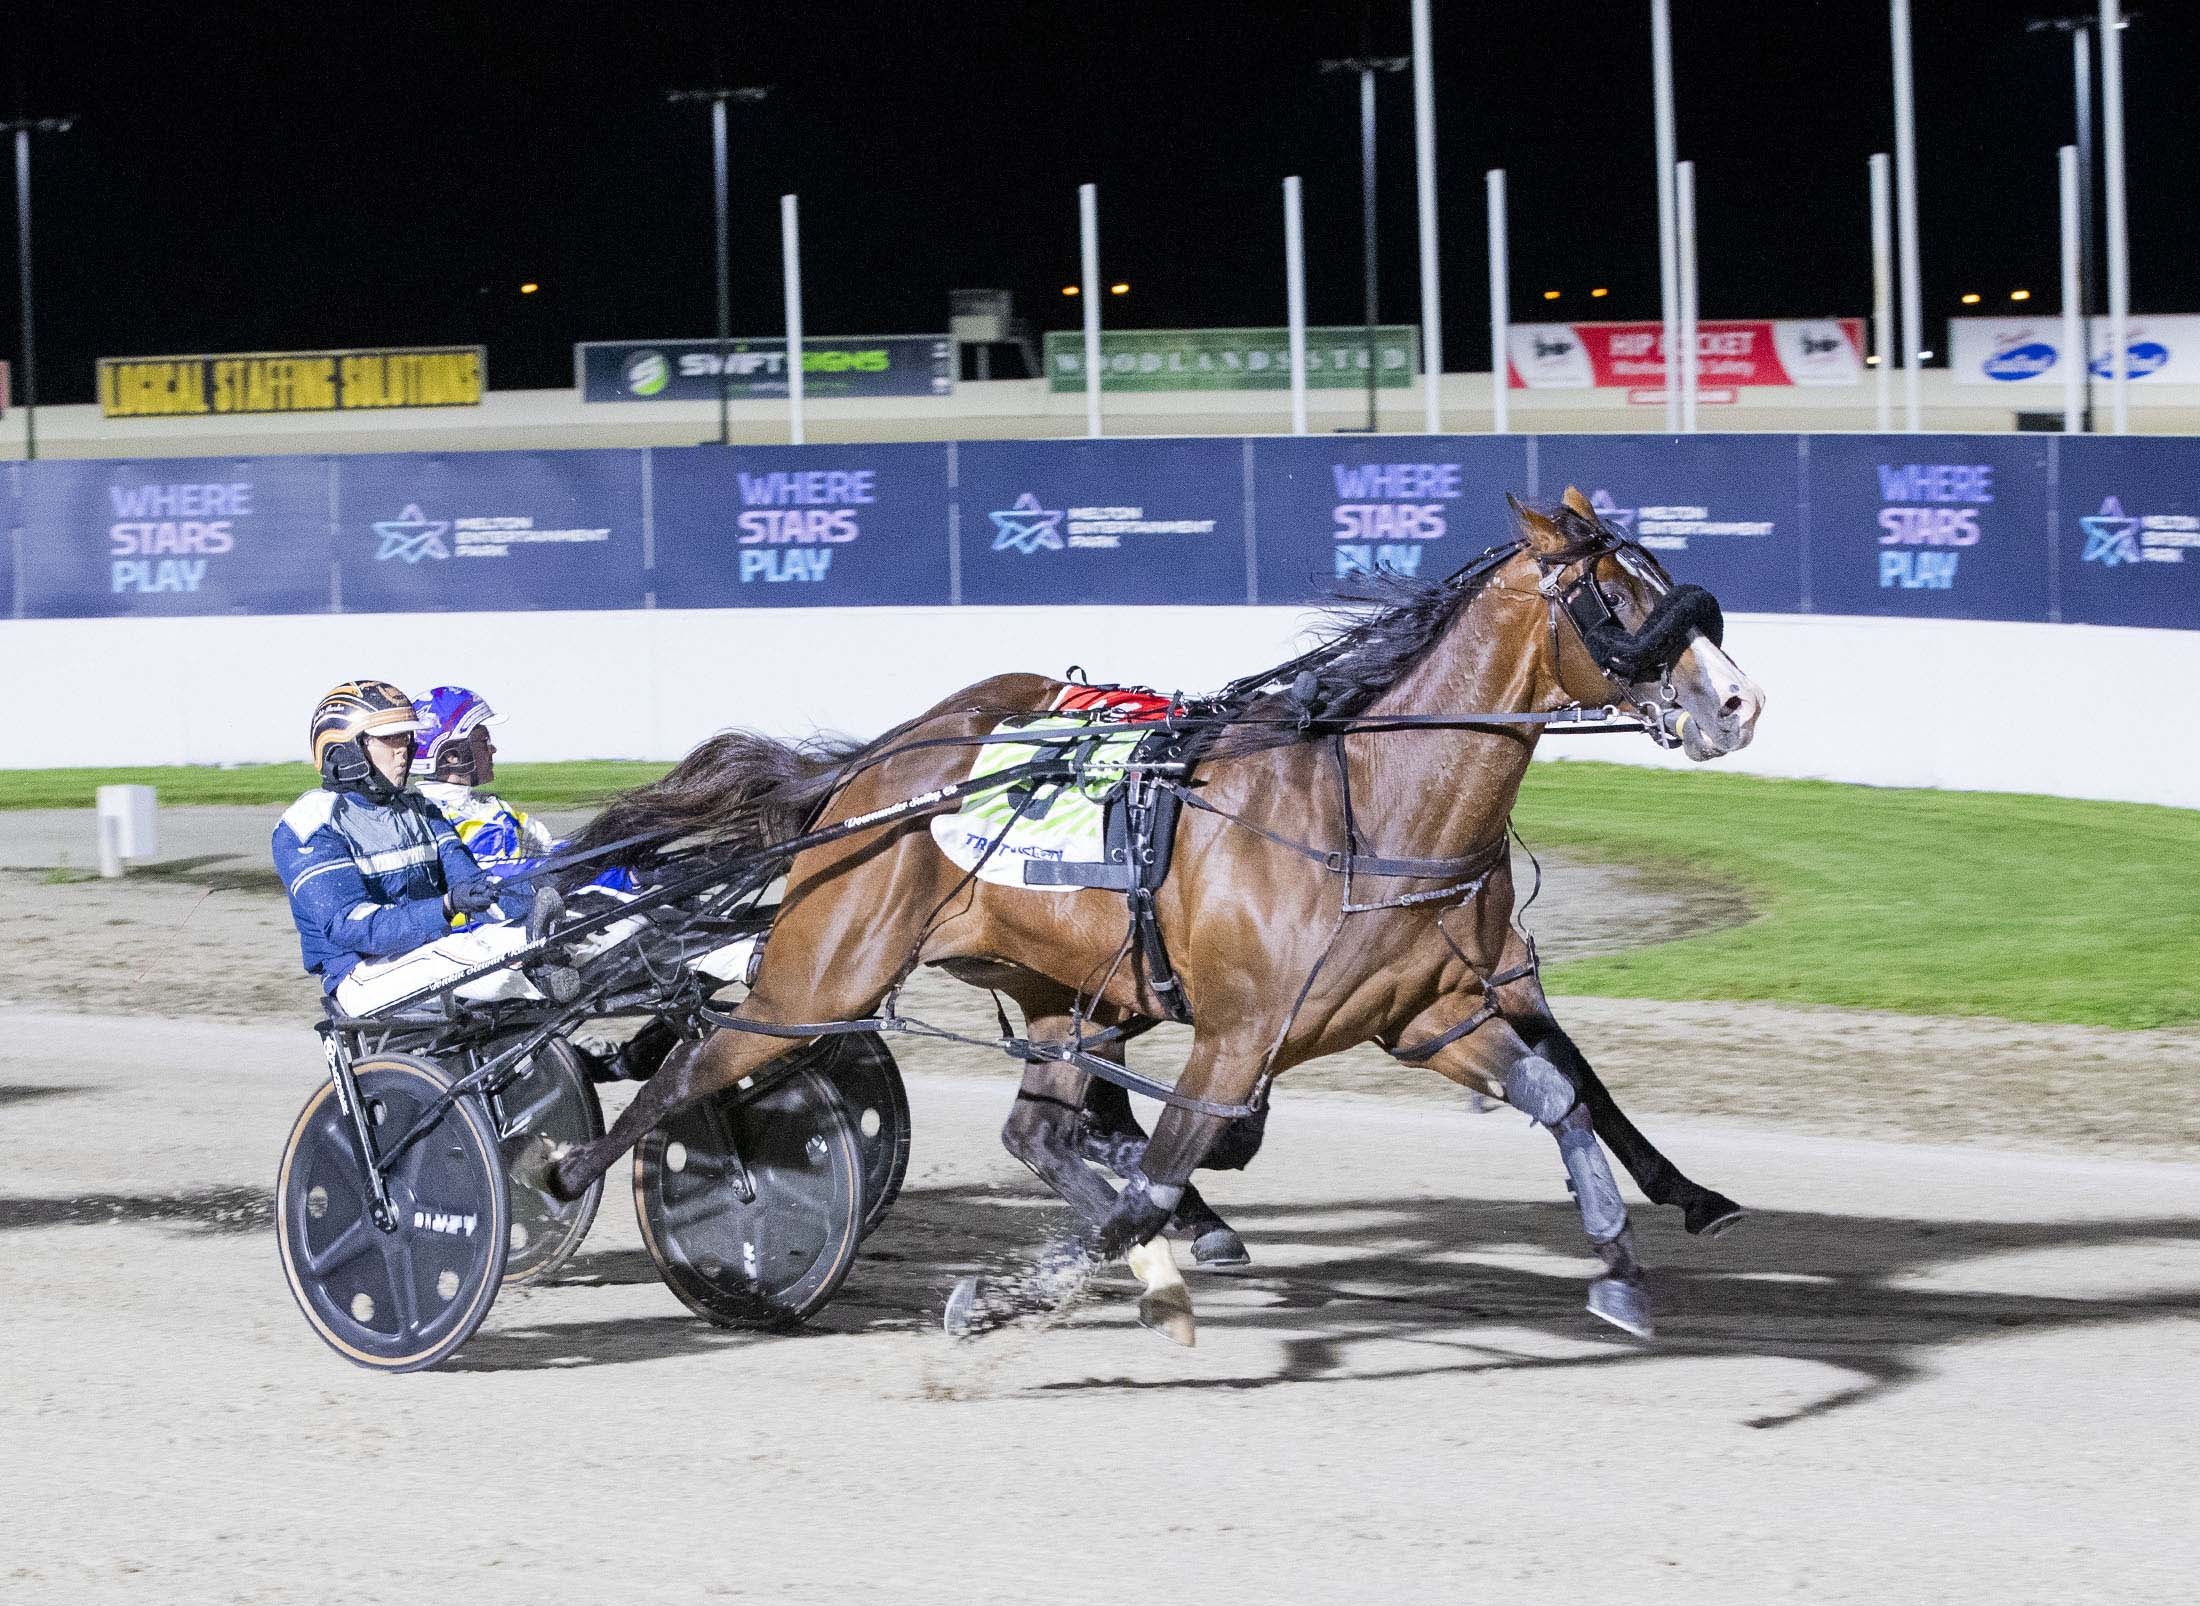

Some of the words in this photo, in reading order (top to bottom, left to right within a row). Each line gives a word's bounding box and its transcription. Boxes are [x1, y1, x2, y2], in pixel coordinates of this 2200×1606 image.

[737, 469, 876, 505] WHERE
[1332, 463, 1462, 498] WHERE
[1877, 464, 1995, 502] WHERE
[109, 483, 253, 518] WHERE
[109, 521, 234, 556] STARS
[737, 509, 859, 545] STARS
[1332, 504, 1447, 540] STARS
[1878, 507, 1982, 545] STARS
[111, 559, 207, 594] PLAY
[738, 548, 831, 583] PLAY
[1878, 550, 1960, 589] PLAY
